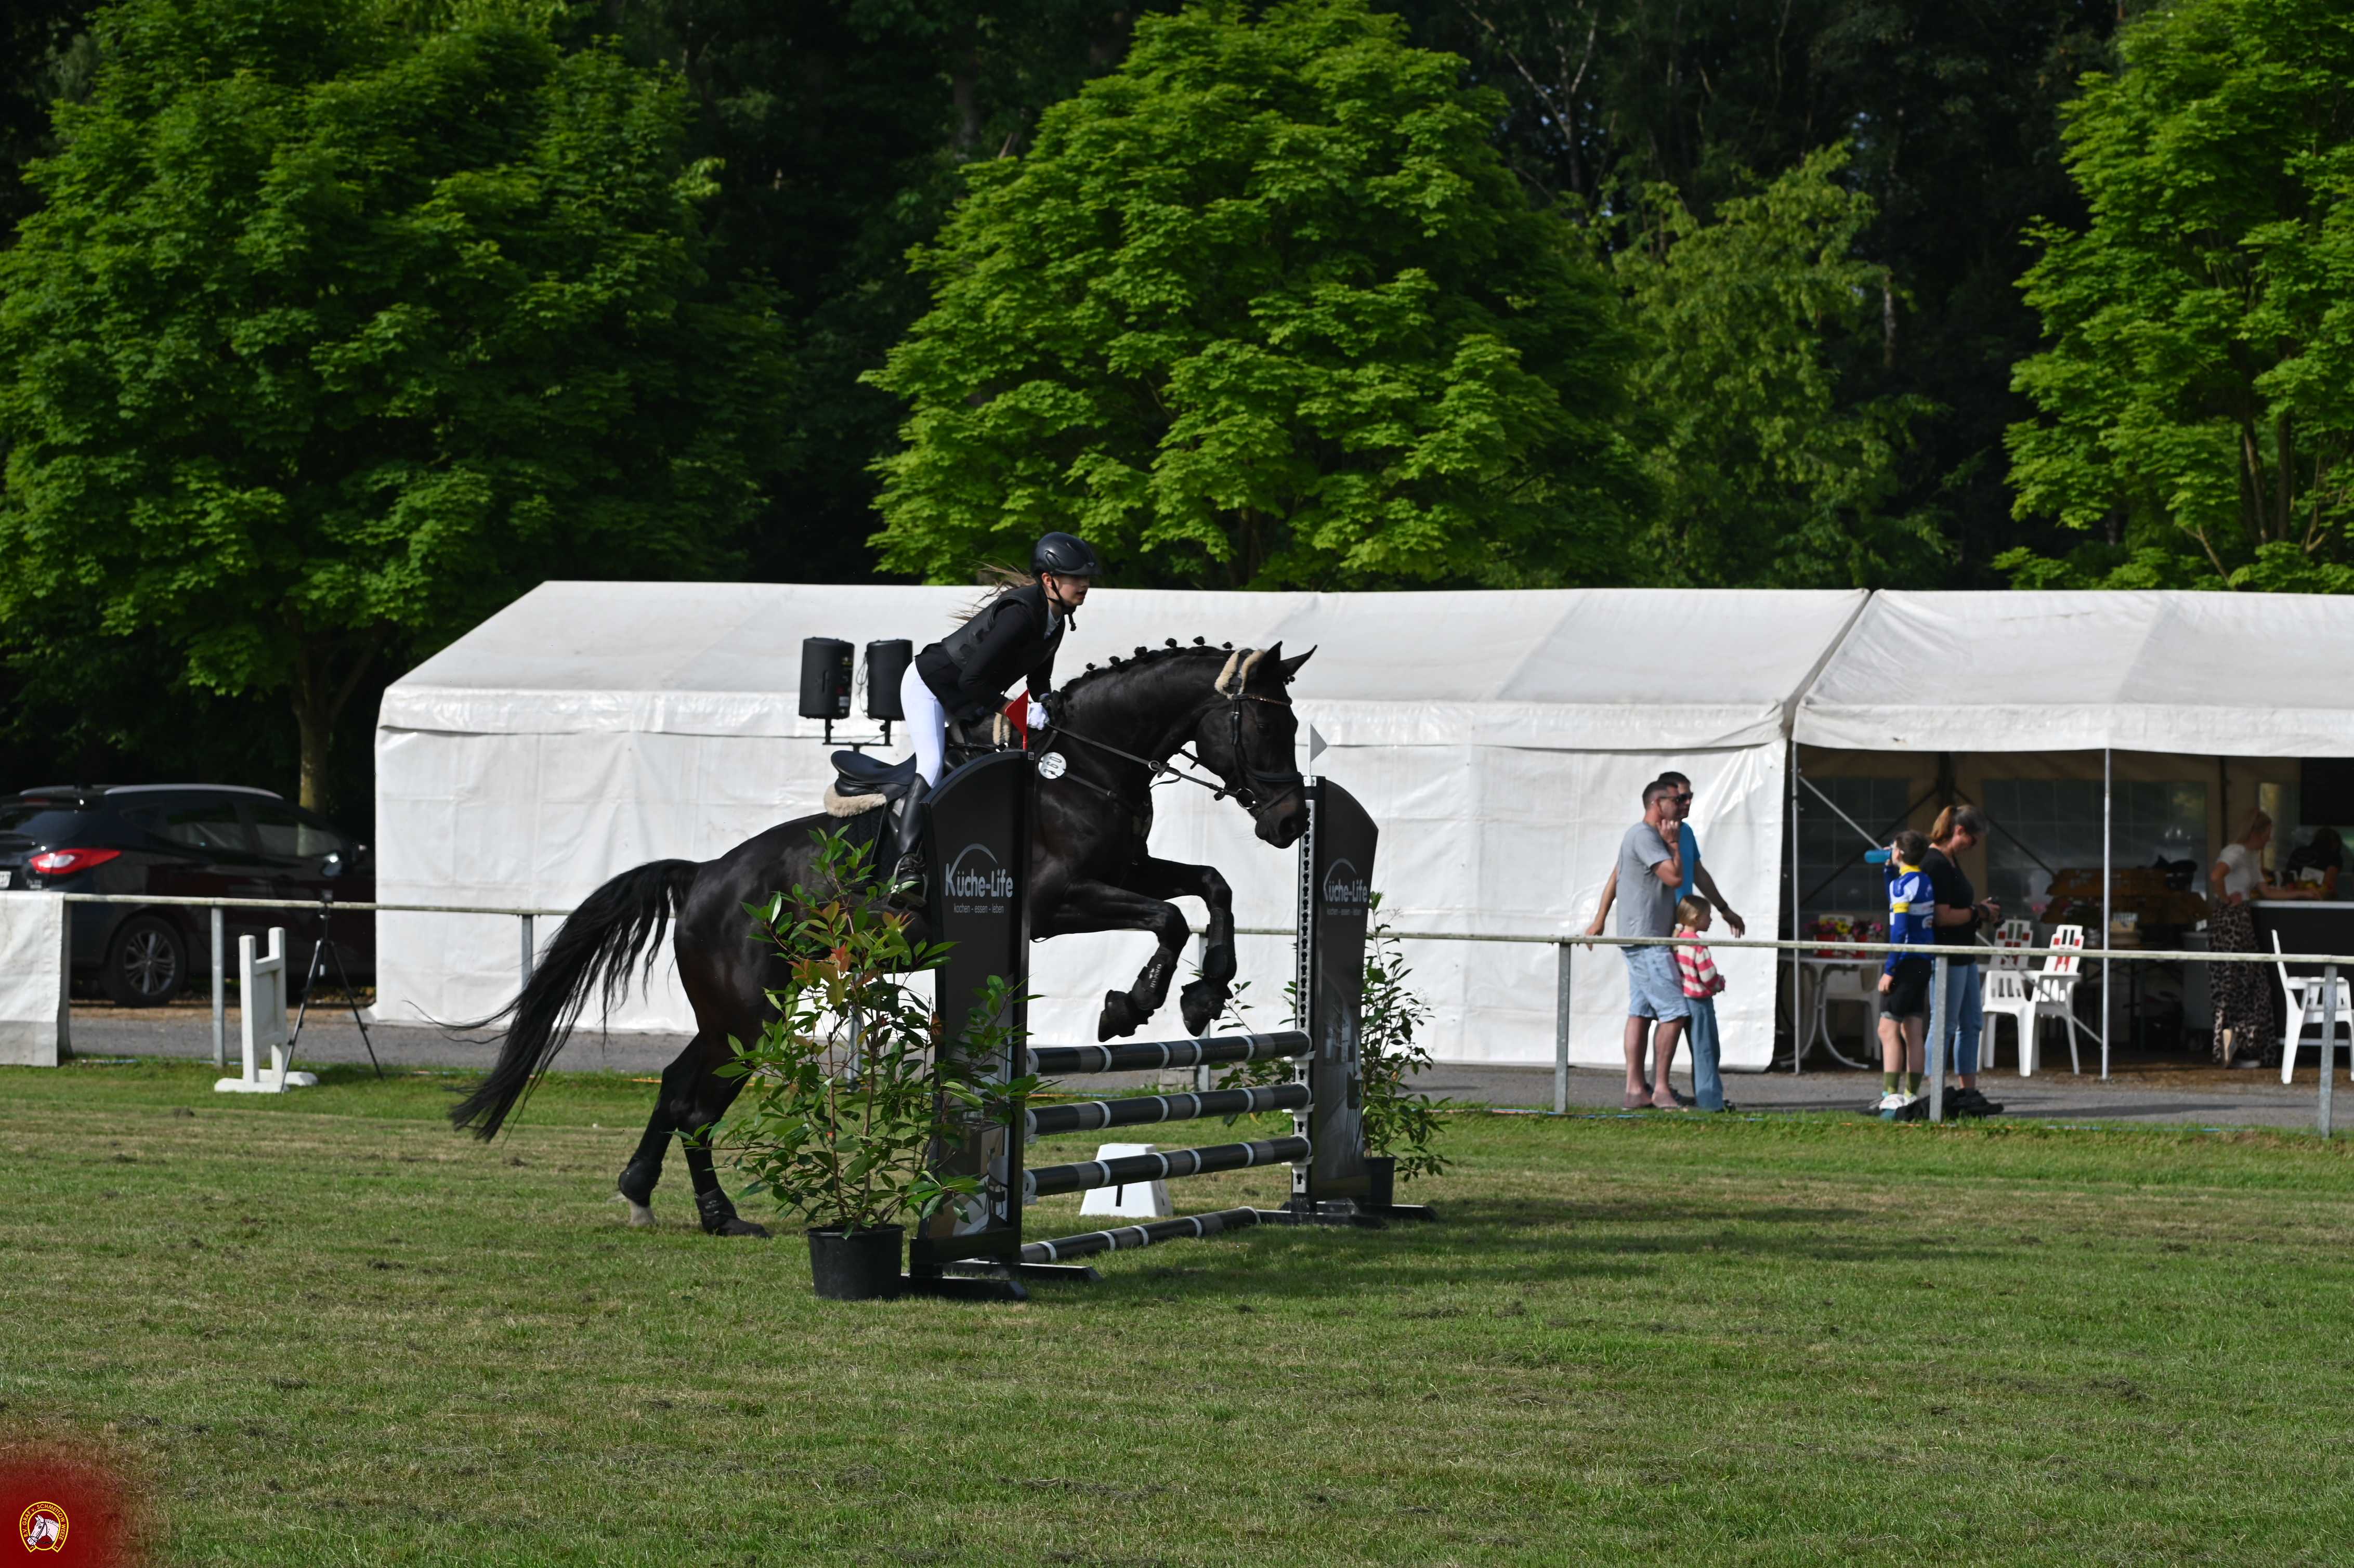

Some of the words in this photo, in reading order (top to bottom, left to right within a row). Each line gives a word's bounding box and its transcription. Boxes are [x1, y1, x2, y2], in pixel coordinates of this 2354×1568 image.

[945, 863, 1013, 898] Küche-Life
[953, 903, 970, 913] kochen
[992, 903, 1004, 913] leben
